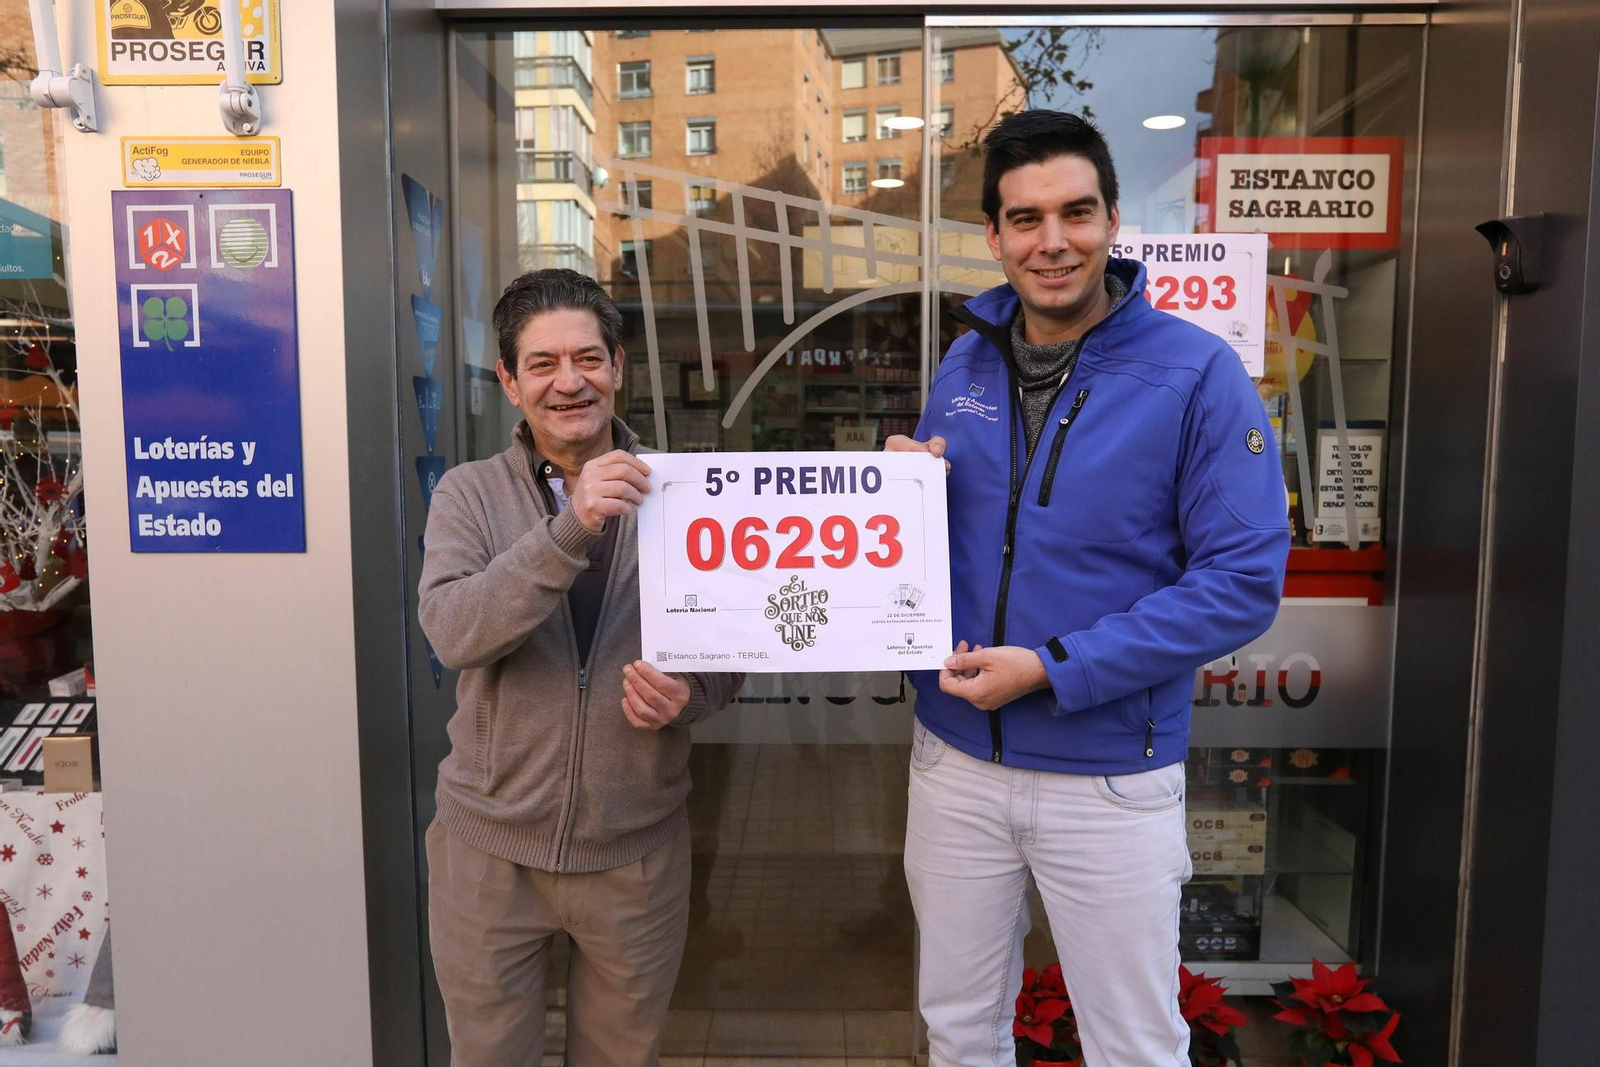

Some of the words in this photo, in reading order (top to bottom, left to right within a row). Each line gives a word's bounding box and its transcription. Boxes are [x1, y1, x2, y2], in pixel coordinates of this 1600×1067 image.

[110, 13, 147, 21] PROSEGUR
[111, 40, 265, 62] PROSEGR
[132, 146, 169, 157] ActiFog
[1230, 169, 1375, 191] ESTANCO
[1229, 200, 1374, 219] SAGRARIO
[1142, 243, 1226, 263] PREMIO
[0, 264, 24, 273] ultos.
[133, 435, 235, 460] Loterías
[241, 440, 257, 466] y
[136, 475, 249, 504] Apuestas
[256, 473, 294, 498] del
[754, 465, 883, 495] PREMIO
[138, 512, 222, 537] Estado
[686, 514, 904, 572] 06293
[779, 574, 808, 596] EL
[764, 589, 829, 620] SORTEO
[780, 612, 803, 625] QUE
[804, 606, 828, 625] NOS
[774, 623, 817, 651] UNE
[668, 652, 698, 660] Estanco
[699, 652, 731, 662] Sagrario
[737, 651, 770, 660] TERUEL
[1193, 819, 1225, 830] OCB
[1191, 851, 1223, 861] OCB
[52, 905, 84, 936] Feliz
[1195, 936, 1238, 950] OCB
